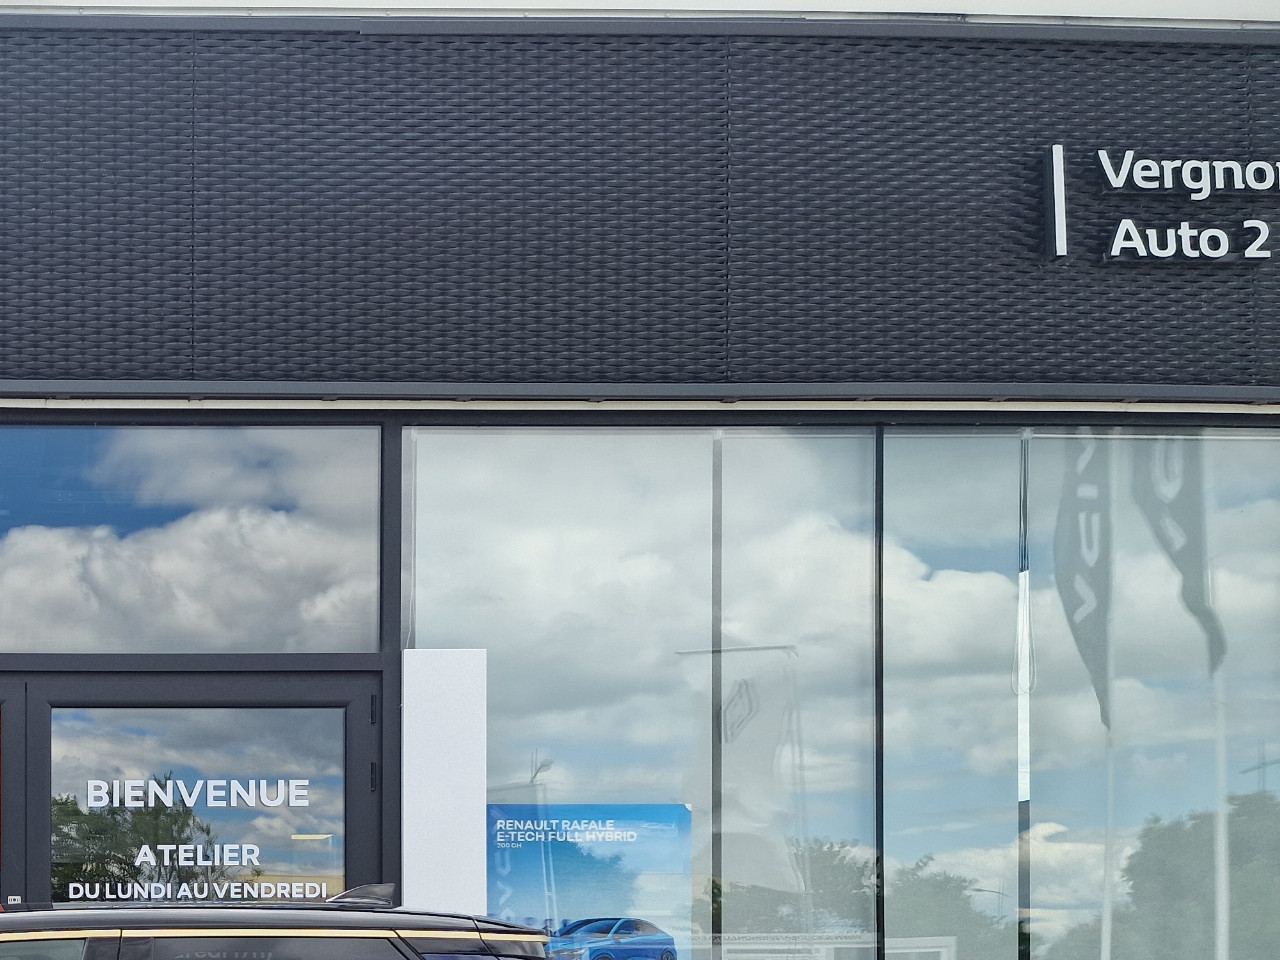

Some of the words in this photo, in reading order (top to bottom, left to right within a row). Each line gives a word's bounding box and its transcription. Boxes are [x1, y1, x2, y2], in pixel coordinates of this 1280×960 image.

[1110, 218, 1230, 258] Auto
[1243, 219, 1272, 258] 2
[87, 779, 310, 807] BIENVENUE
[496, 820, 559, 831] RENAULT
[561, 820, 615, 831] RAFALE
[496, 831, 545, 842] E-TECH
[548, 831, 583, 842] FULL
[585, 831, 638, 842] HYBRID
[134, 844, 261, 866] ATELIER
[68, 882, 100, 899] DU
[105, 882, 172, 899] LUNDI
[177, 882, 214, 899] AU
[215, 882, 327, 899] VENDREDI
